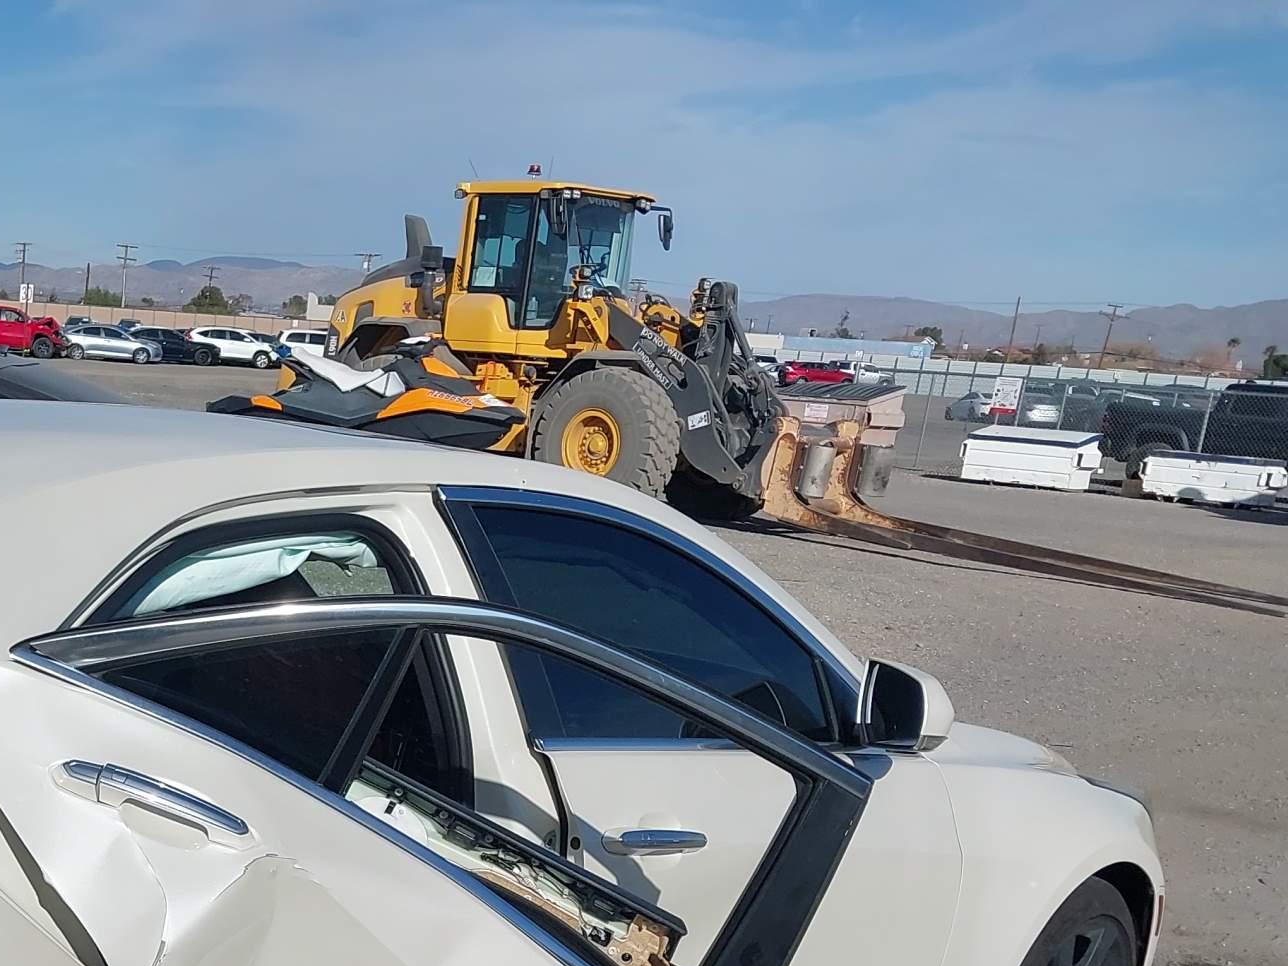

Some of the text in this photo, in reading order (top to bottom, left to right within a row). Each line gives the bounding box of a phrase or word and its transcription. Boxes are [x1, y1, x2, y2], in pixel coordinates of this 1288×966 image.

[588, 197, 620, 208] VOLVO
[642, 329, 686, 366] DO NOT WALK
[637, 347, 670, 386] UNDER MAST
